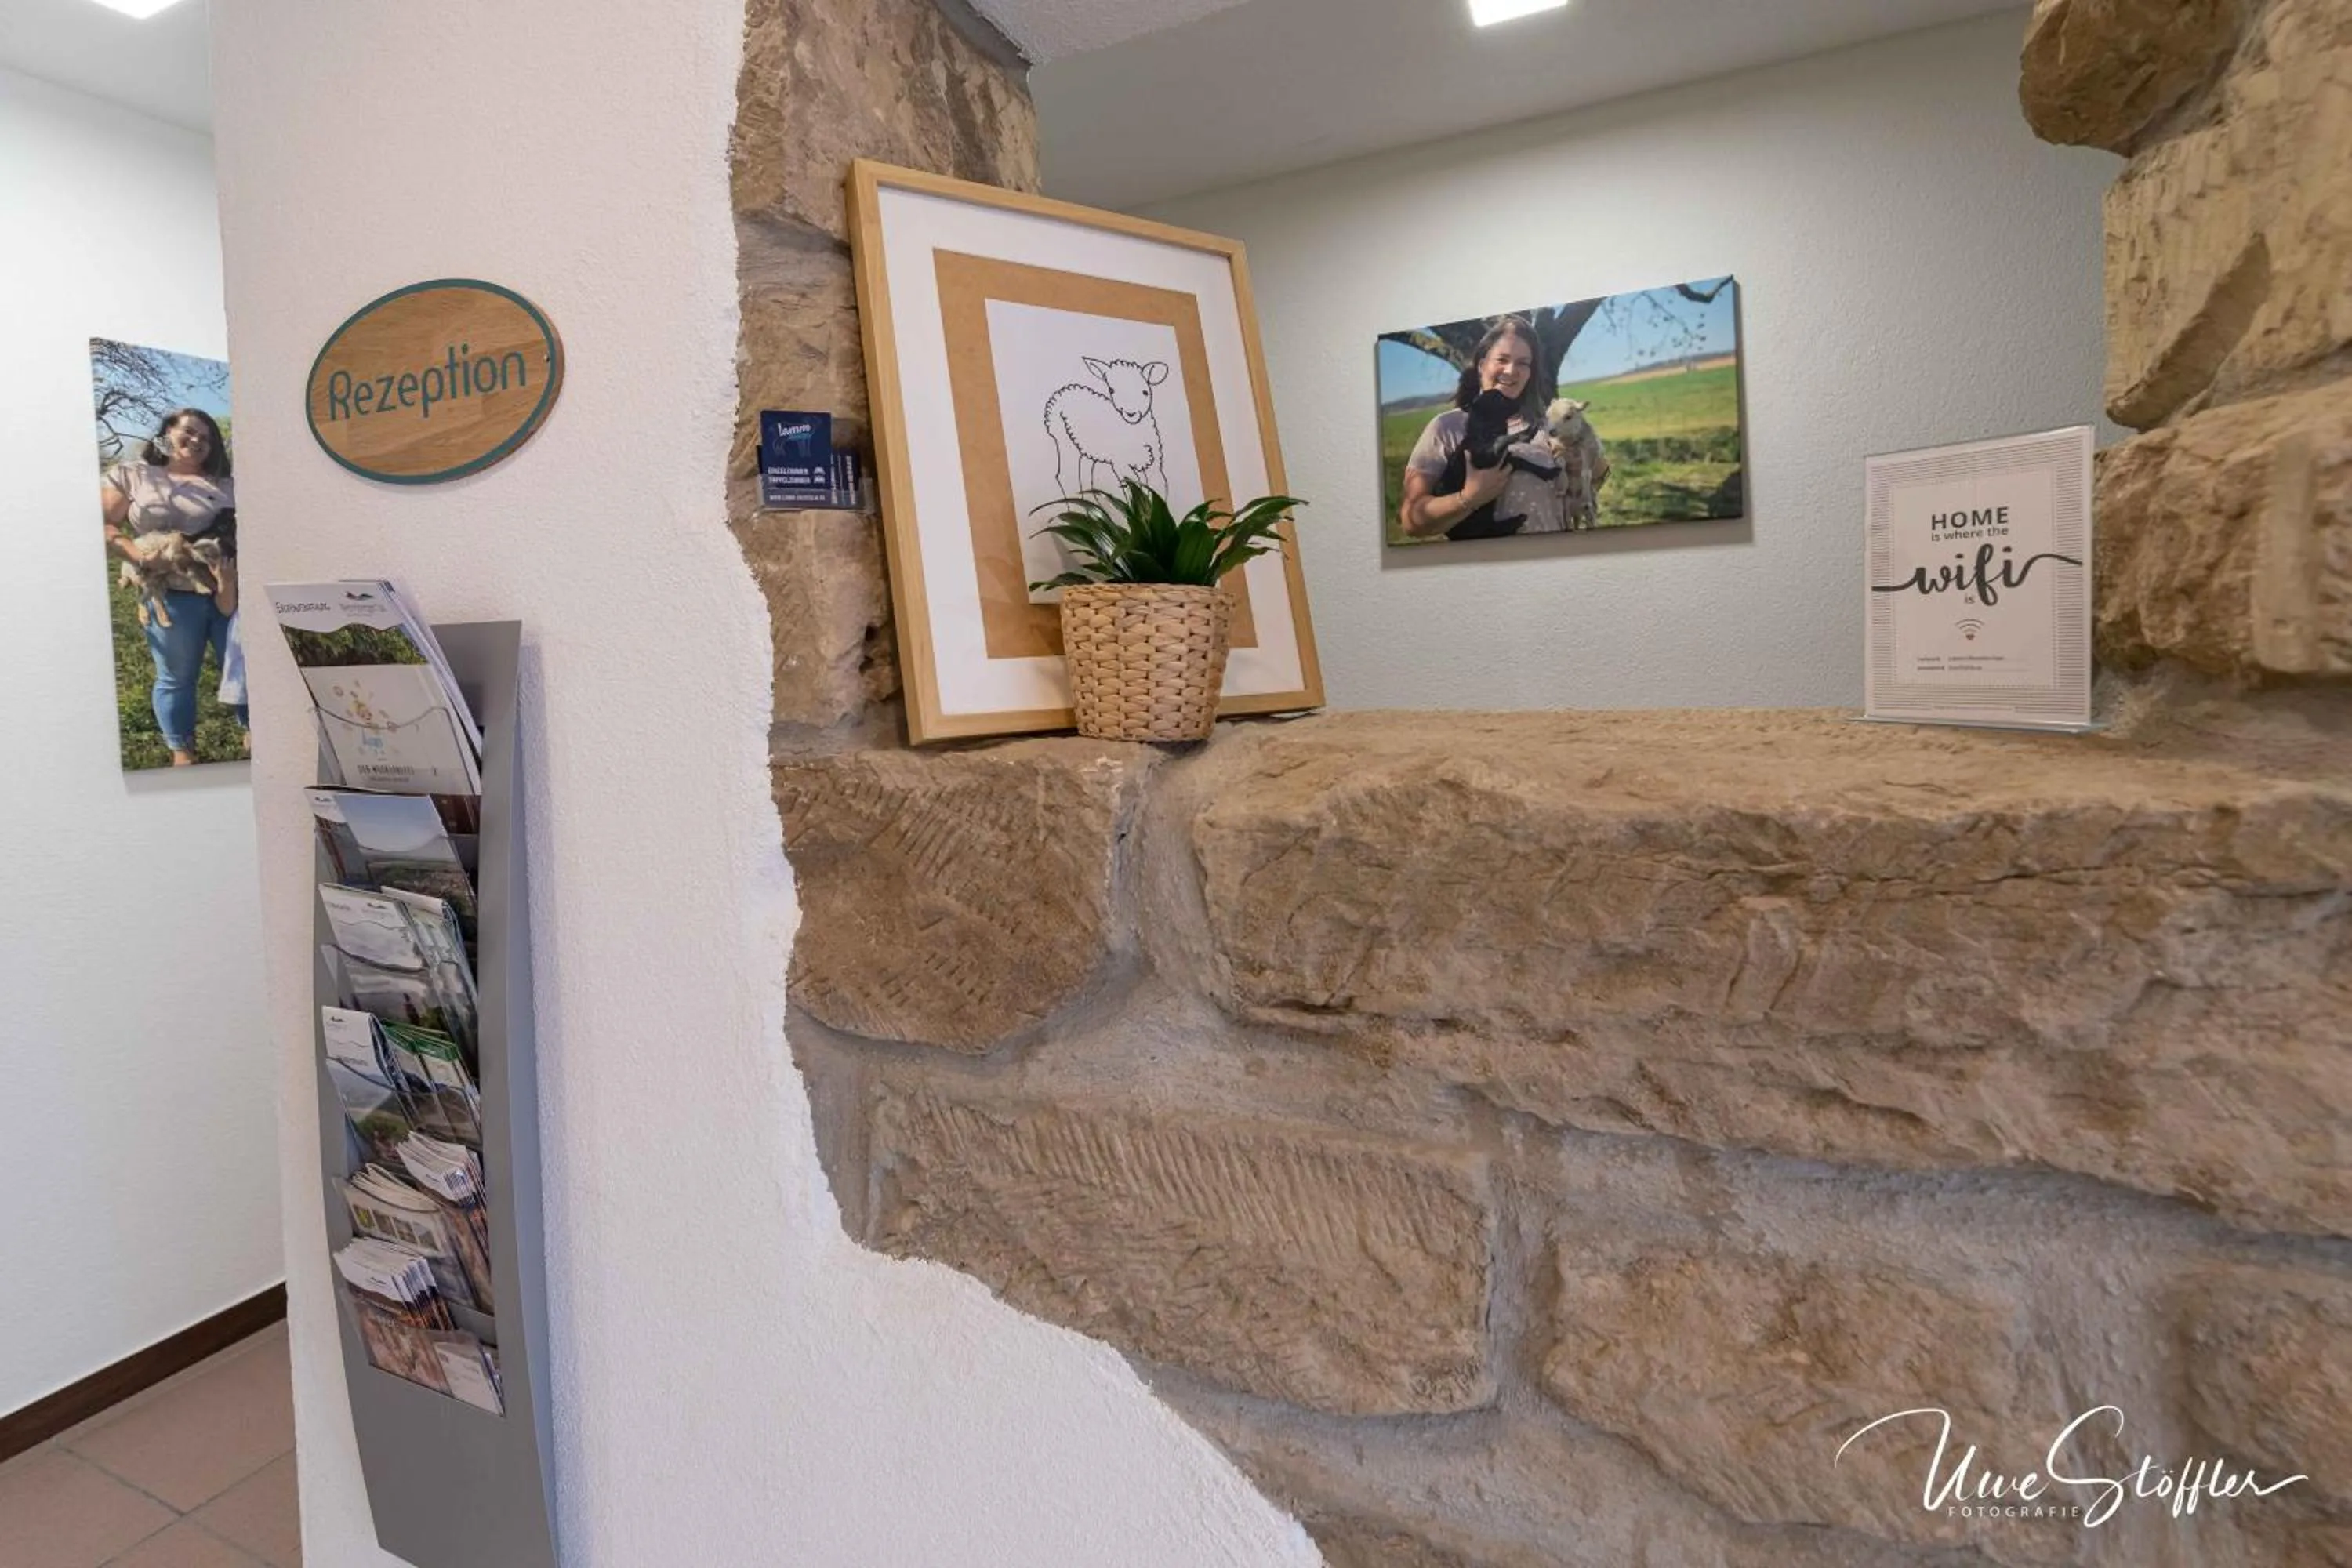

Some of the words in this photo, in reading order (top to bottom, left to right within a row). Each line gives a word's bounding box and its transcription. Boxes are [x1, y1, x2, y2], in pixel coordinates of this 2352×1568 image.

[329, 343, 526, 421] Rezeption
[1931, 506, 2009, 531] HOME
[1931, 533, 1941, 542] is
[1944, 528, 1984, 540] where
[1987, 526, 2009, 537] the
[1871, 543, 2082, 607] wifi
